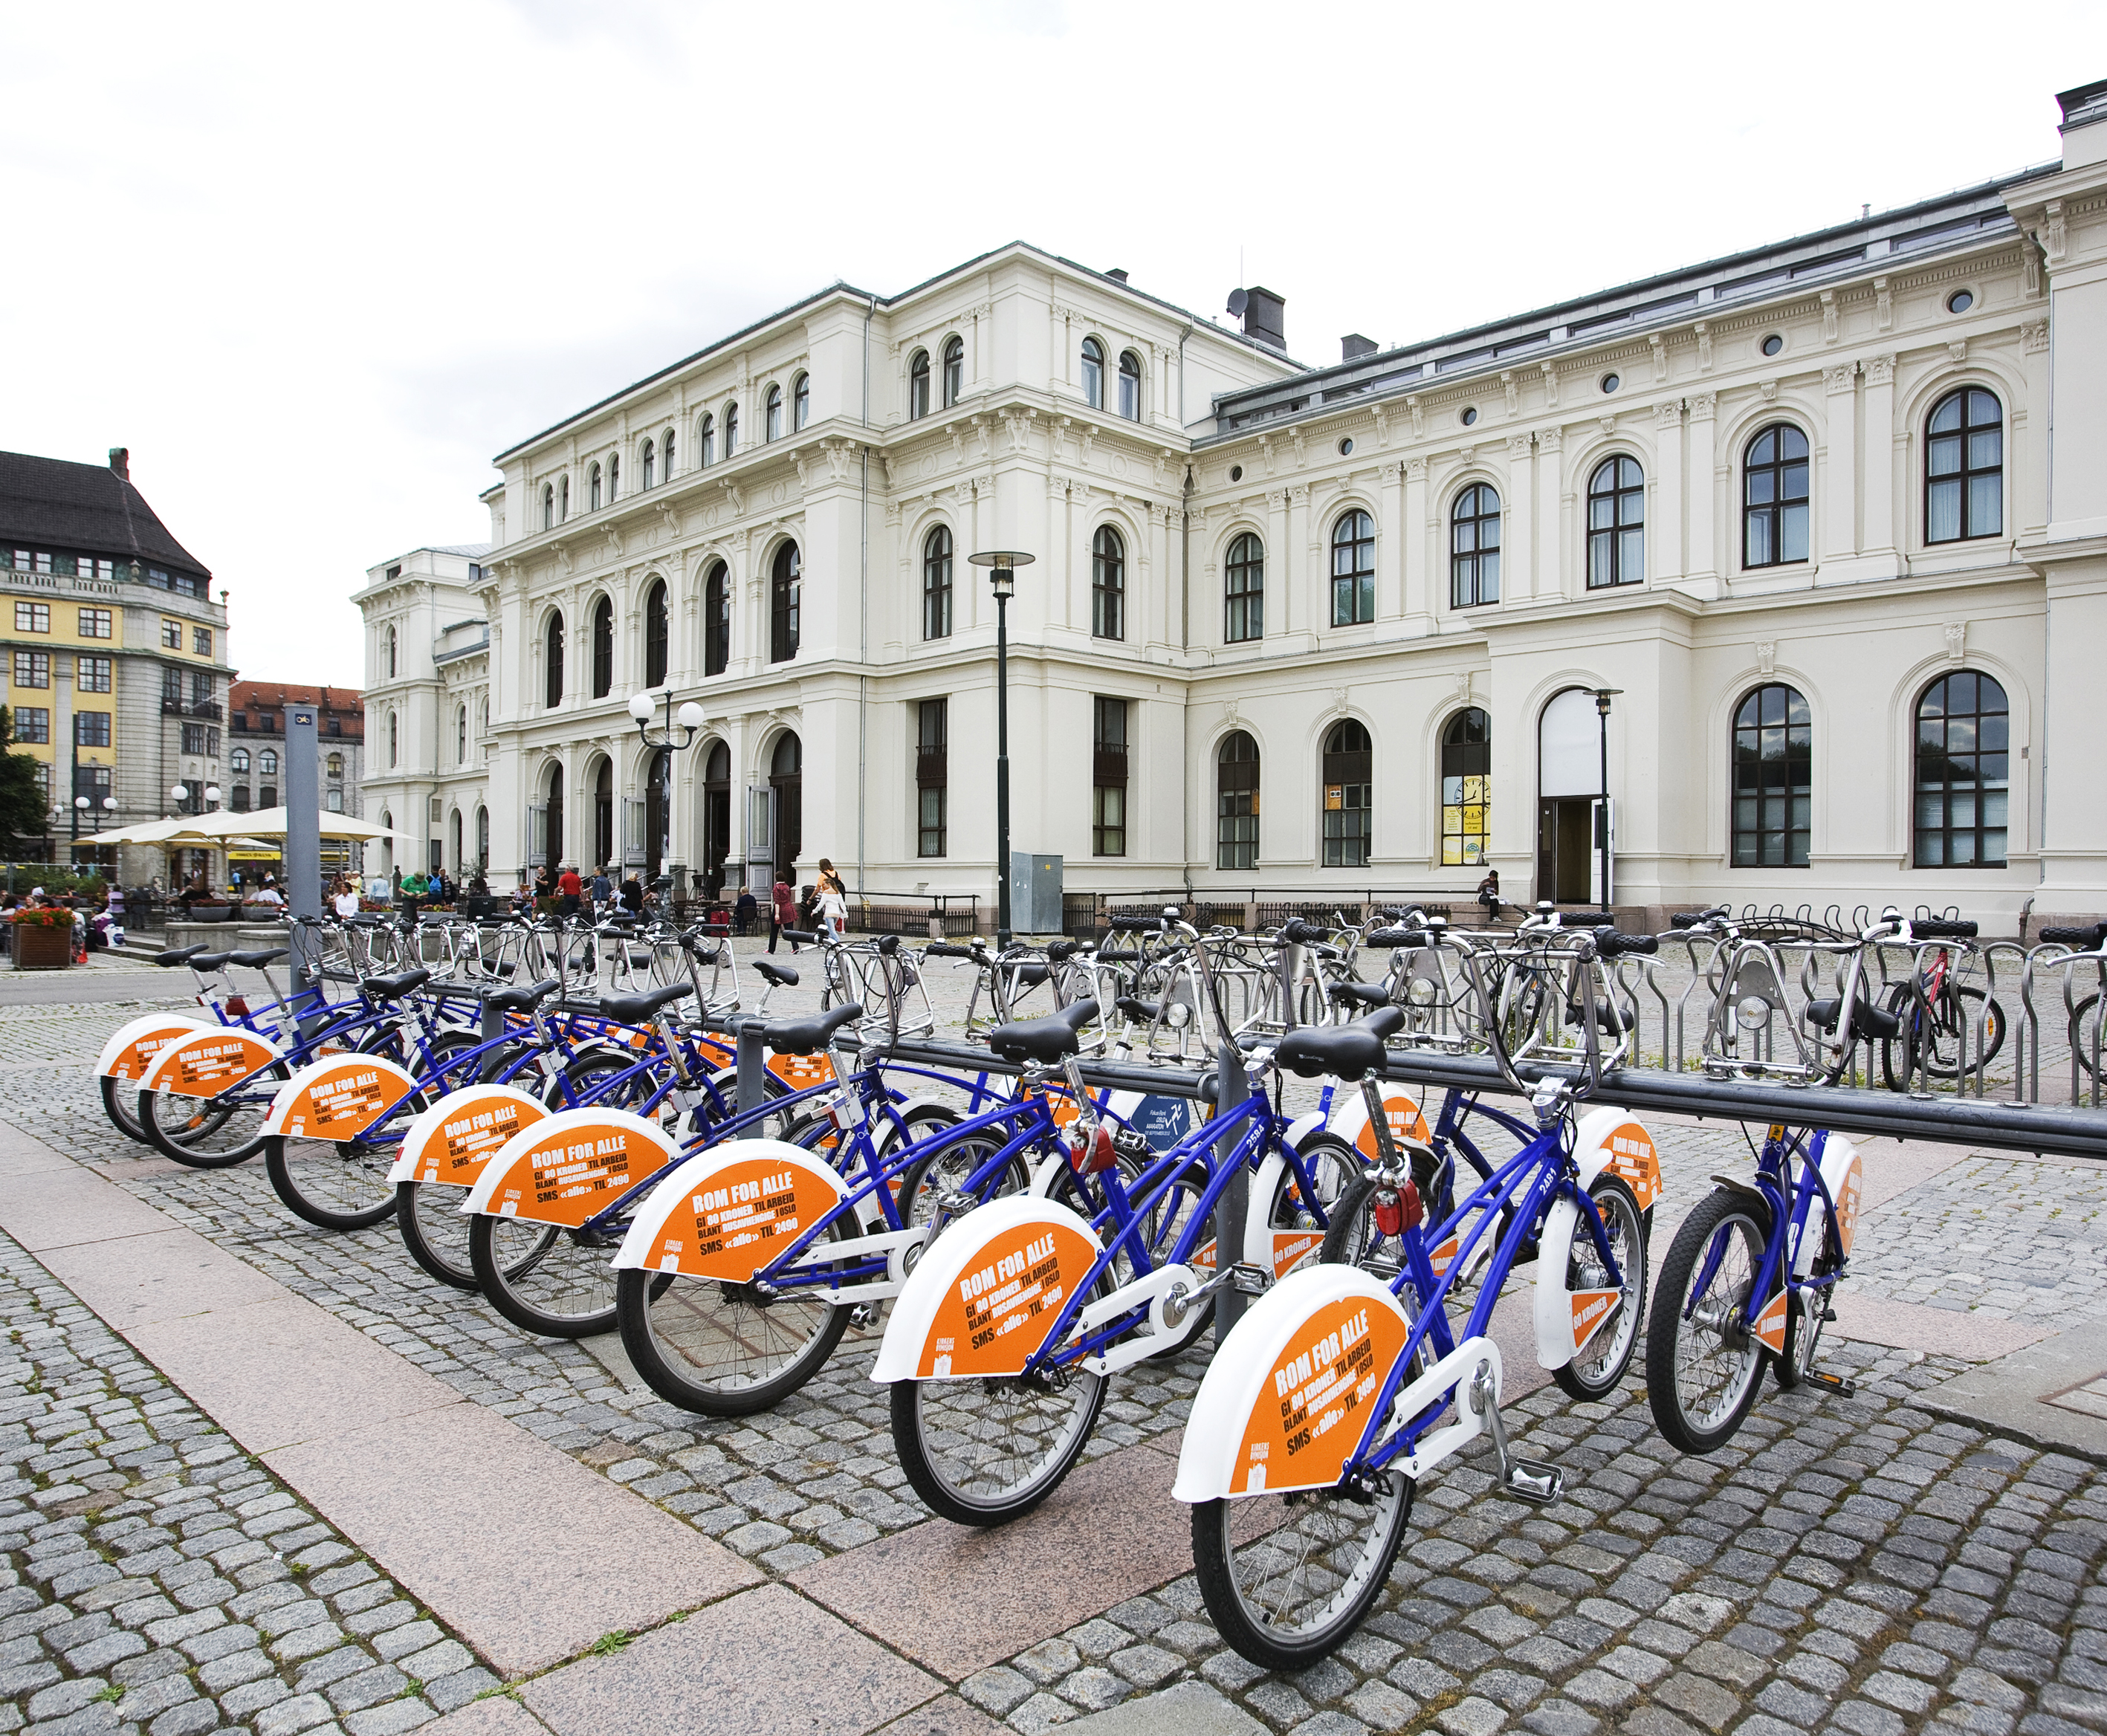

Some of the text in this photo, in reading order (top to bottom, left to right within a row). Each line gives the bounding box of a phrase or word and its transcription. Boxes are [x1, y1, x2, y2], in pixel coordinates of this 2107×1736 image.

[136, 1040, 158, 1052] ROM
[179, 1043, 244, 1063] ROM FOR ALLE
[309, 1071, 378, 1099] ROM FOR ALLE
[317, 1115, 332, 1125] SMS
[357, 1104, 367, 1113] TIL
[367, 1100, 383, 1111] 2490
[444, 1104, 517, 1139] ROM FOR ALLE
[1394, 1112, 1405, 1124] FOR
[448, 1121, 518, 1148] GI 80 KRONER TIL ARBEID
[1246, 1124, 1265, 1149] 2584
[1613, 1136, 1651, 1159] ROM FOR ALLE
[450, 1145, 467, 1156] BLANT
[452, 1156, 469, 1168] SMS
[531, 1136, 627, 1169] ROM FOR ALLE
[534, 1153, 627, 1181] GI 80 KRONER TIL ARBEID
[535, 1178, 557, 1189] BLANT
[558, 1167, 608, 1185] RUSAVHENGIGE
[612, 1162, 628, 1173] OSLO
[1539, 1167, 1557, 1196] 2481
[537, 1173, 629, 1203] SMS «alle» TIL 2490
[693, 1171, 793, 1214] ROM FOR ALLE
[696, 1193, 794, 1228] GI 80 KRONER TIL ARBEID
[698, 1204, 796, 1239] BLANT RUSAVHENGIGE I OSLO
[700, 1217, 798, 1255] SMS «alle» TIL 2490
[1274, 1236, 1312, 1265] 80 KRONER
[959, 1232, 1055, 1303] ROM FOR ALLE
[1203, 1251, 1211, 1264] 80
[965, 1257, 1058, 1318] GI 80 KRONER TIL ARBEID
[968, 1270, 1060, 1331] BLANT RUSAVHENGIGE I OSLO
[971, 1285, 1063, 1350] SMS «alle» TIL 2490
[1573, 1295, 1608, 1330] 80 KRONER
[1275, 1308, 1369, 1398] ROM FOR ALLE
[1281, 1338, 1371, 1417] GI 80 KRONER TIL ARBEID
[1284, 1353, 1373, 1433] BLANT RUSAVHENGIGE I OSLO
[1286, 1372, 1376, 1456] SMS «alle» TIL 2490
